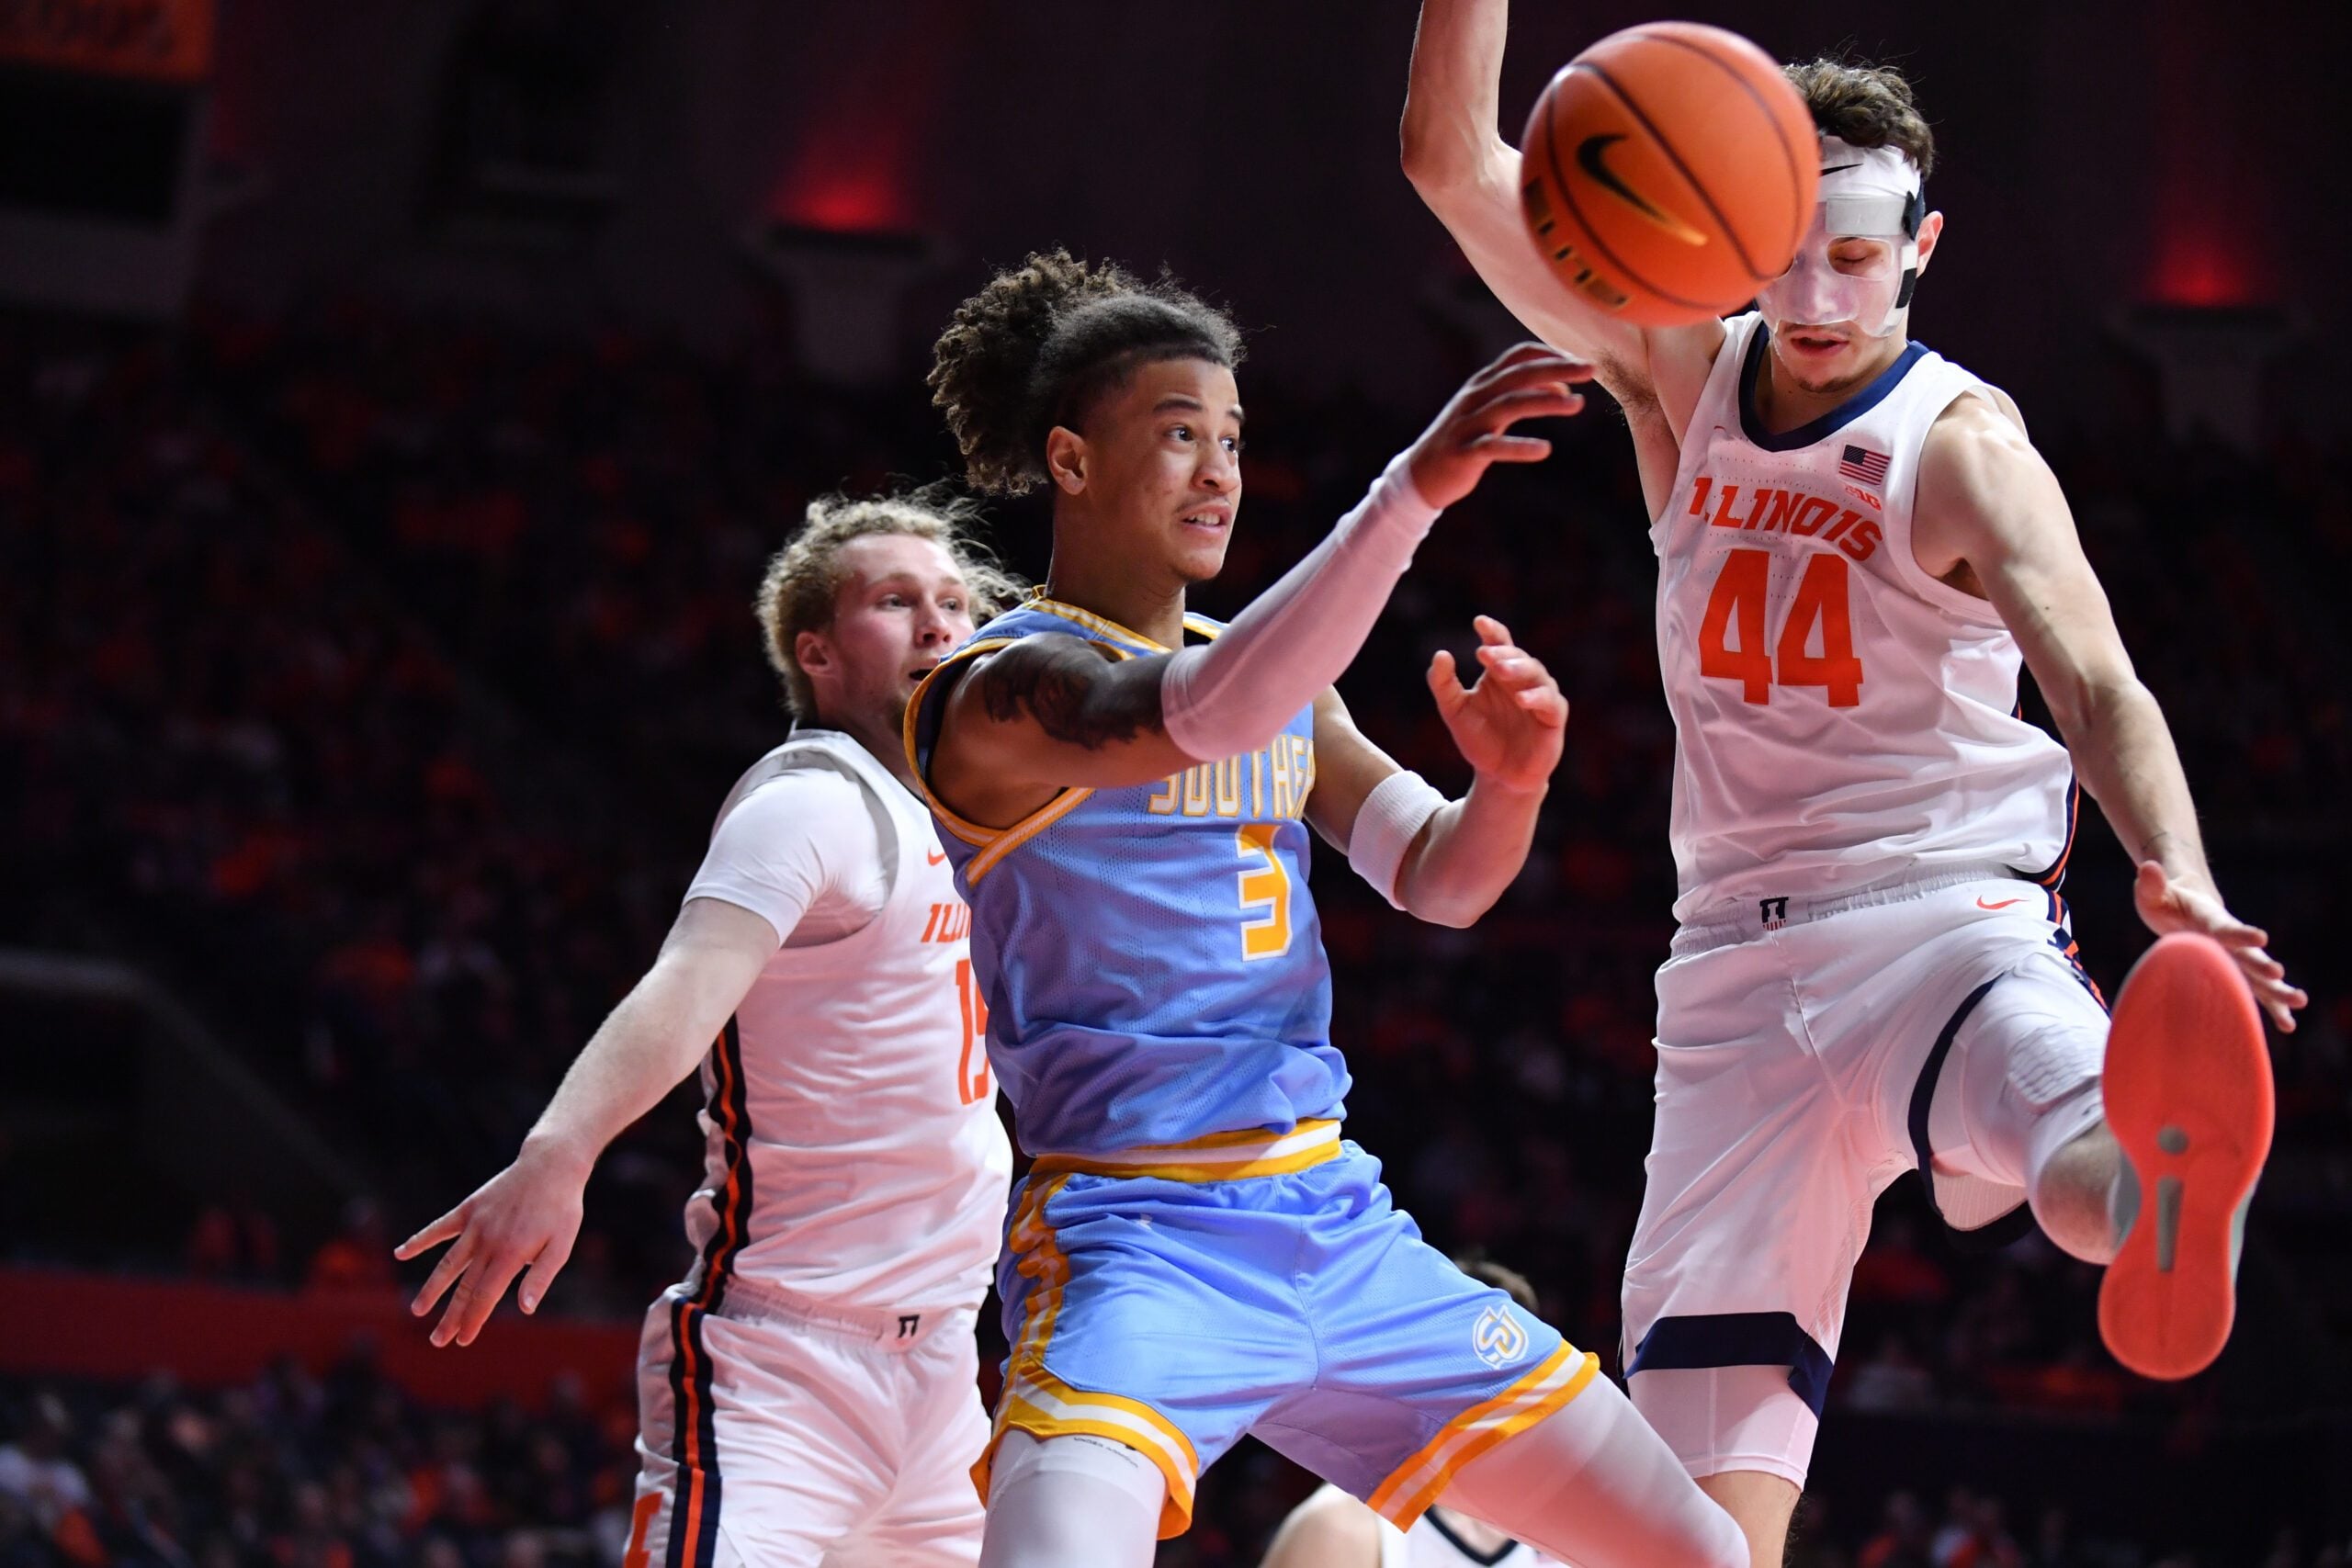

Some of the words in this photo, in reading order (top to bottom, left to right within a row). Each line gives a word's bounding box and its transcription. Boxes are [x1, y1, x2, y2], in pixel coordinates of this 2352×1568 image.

[1689, 477, 1883, 562] ILINOIS
[1698, 548, 1864, 707] 44
[1235, 824, 1294, 963] 3
